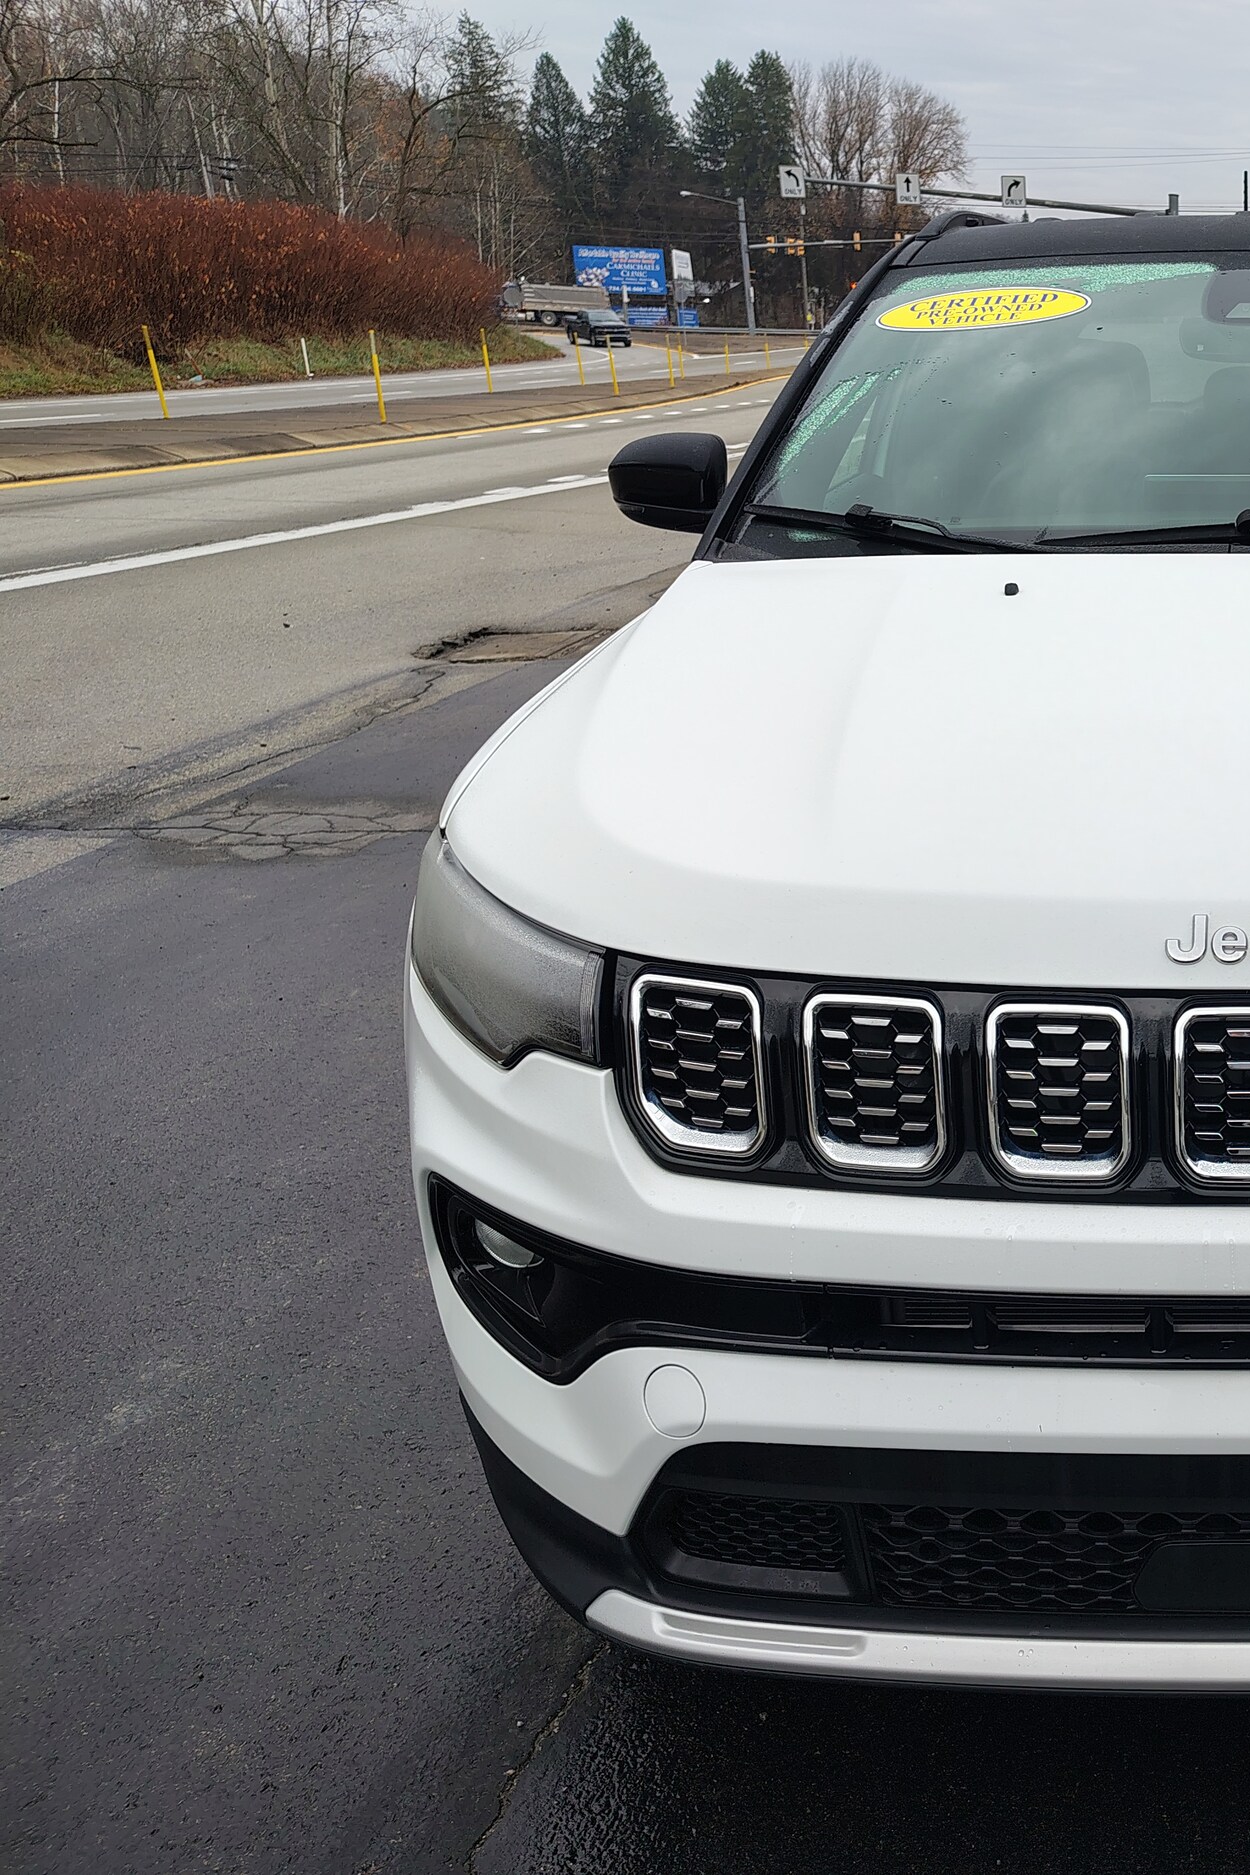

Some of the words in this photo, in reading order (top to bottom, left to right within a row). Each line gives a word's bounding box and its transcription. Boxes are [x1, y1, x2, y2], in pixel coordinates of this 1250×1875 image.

[910, 293, 1059, 312] CERTIFIED
[916, 303, 1043, 319] PRE-OWNED
[929, 312, 1021, 326] VEHICLE
